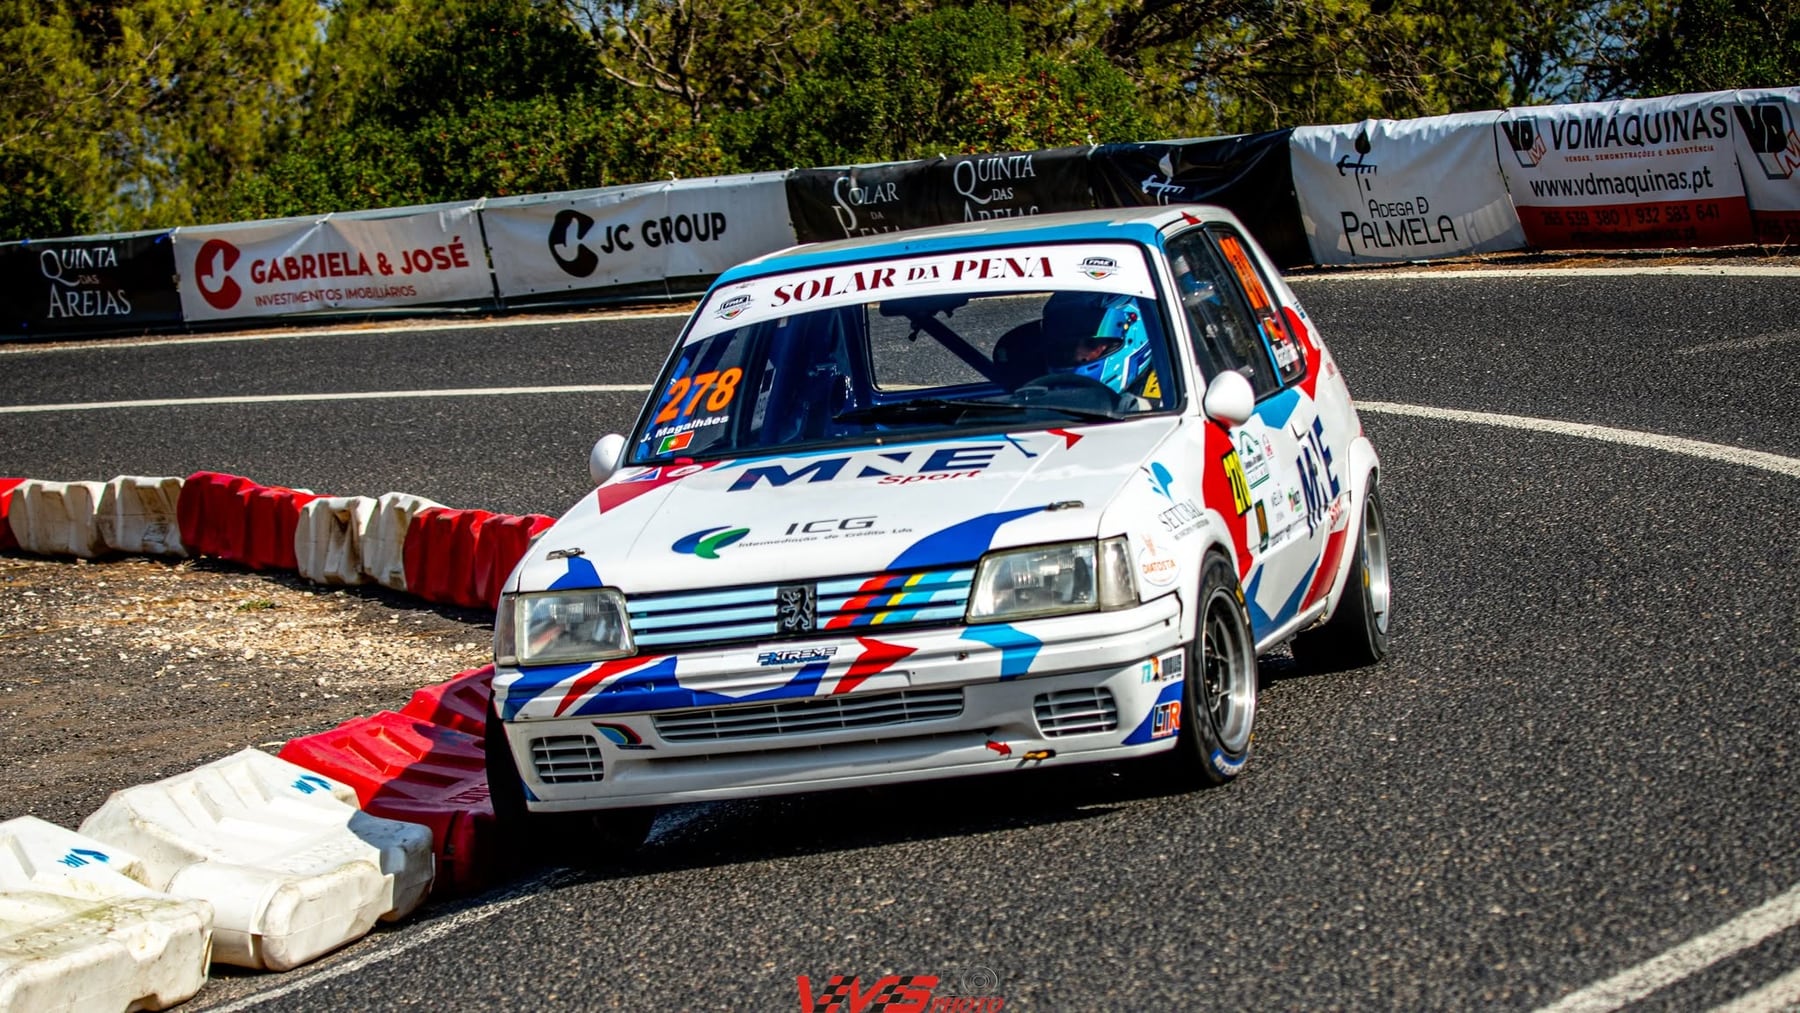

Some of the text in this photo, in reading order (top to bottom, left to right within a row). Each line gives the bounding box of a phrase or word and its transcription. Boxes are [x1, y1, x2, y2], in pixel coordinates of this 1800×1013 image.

[1551, 106, 1728, 150] VDMÁQUINAS
[953, 152, 1036, 205] QUINTA
[992, 187, 1013, 201] DAS
[1530, 165, 1714, 198] www.vdmaquinas.pt
[833, 176, 899, 231] SOLAR
[871, 211, 885, 221] DA
[1368, 198, 1414, 218] ADEGA
[1635, 206, 1660, 225] 932
[600, 212, 727, 254] JC GROUP
[1341, 211, 1459, 257] PALMELA
[40, 246, 118, 287] QUINTA
[250, 235, 470, 285] GABRIELA & JOSÉ
[79, 274, 100, 285] DAS
[254, 284, 417, 307] INVESTIMENTOS IMOBILIÁRIOS
[771, 256, 1054, 308] SOLAR DA PENA
[47, 282, 132, 319] AREIAS
[655, 366, 743, 425] 278
[640, 414, 730, 443] J. Magalhães
[877, 469, 982, 485] Sport
[784, 515, 879, 537] ICG
[757, 646, 838, 663] EXTREME
[1151, 700, 1182, 735] LTR
